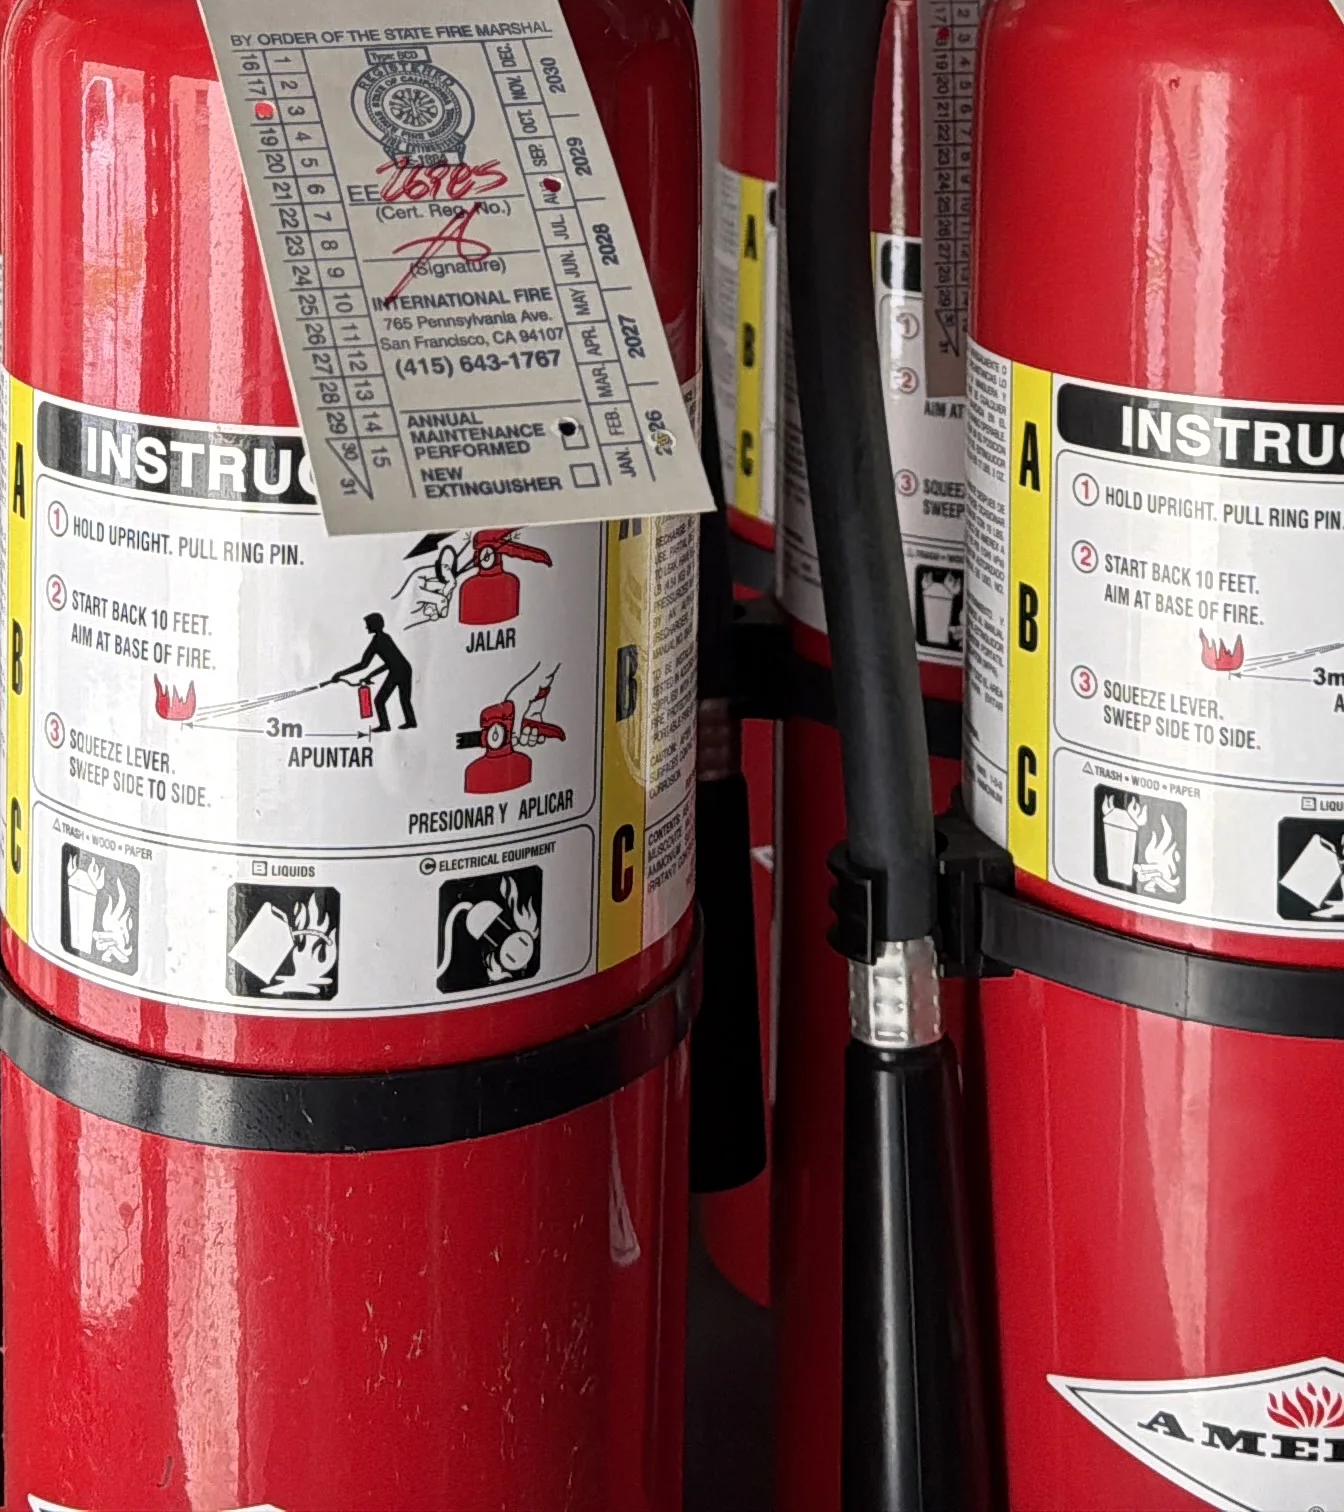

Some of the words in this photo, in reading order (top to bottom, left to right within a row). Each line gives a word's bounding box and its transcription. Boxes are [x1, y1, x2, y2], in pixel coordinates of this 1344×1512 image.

[230, 34, 252, 46] BY
[256, 31, 318, 46] ORDER
[320, 30, 344, 43] OF
[345, 28, 382, 42] THE
[383, 26, 434, 40] STATE
[434, 24, 474, 38] FIRE
[474, 20, 553, 37] MARSHAL
[539, 56, 566, 93] 2030
[346, 183, 383, 202] EE
[374, 202, 424, 224] (Cert.
[371, 289, 511, 312] INTERNATIONAL
[512, 286, 553, 303] FIRE
[379, 336, 411, 351] San
[413, 333, 490, 349] Francisco,
[492, 329, 517, 345] CA
[518, 326, 564, 343] 94107
[382, 316, 413, 331] 765
[416, 310, 517, 329] Pennsylvania
[520, 309, 553, 323] Ave.
[395, 355, 454, 381] (415)
[459, 349, 561, 373] 643-1767
[407, 411, 483, 428] ANNUAL
[409, 422, 546, 444] MAINTENANCE
[414, 439, 530, 460] PERFORMED
[1019, 421, 1041, 491] A
[13, 441, 25, 520] A
[420, 466, 462, 482] NEW
[424, 476, 563, 499] EXTINGUISHER
[1106, 486, 1142, 511] HOLD
[1147, 494, 1217, 521] UPRIGHT.
[1224, 504, 1264, 526] PULL
[1269, 507, 1309, 529] RING
[73, 515, 104, 543] HOLD
[109, 525, 173, 555] UPRIGHT.
[179, 536, 217, 560] PULL
[224, 541, 263, 564] RING
[269, 544, 304, 566] PIN.
[1105, 554, 1148, 580] START
[1152, 563, 1191, 588] BACK
[1196, 571, 1213, 589] 10
[1219, 572, 1259, 594] FEET.
[72, 590, 107, 618] START
[112, 600, 146, 627] BACK
[151, 609, 168, 630] 10
[173, 612, 212, 636] FEET.
[1019, 581, 1038, 653] B
[1104, 584, 1129, 606] AIM
[1134, 591, 1151, 610] AT
[1155, 594, 1194, 617] BASE
[1198, 600, 1219, 620] OF
[1223, 604, 1264, 626] FIRE.
[12, 618, 23, 696] B
[71, 623, 92, 647] AIM
[96, 631, 111, 651] AT
[115, 635, 148, 661] BASE
[153, 642, 172, 664] OF
[178, 647, 216, 670] FIRE.
[465, 628, 516, 654] JALAR
[616, 645, 637, 722] B
[1104, 680, 1166, 711] SQUEEZE
[1170, 695, 1224, 720] LEVER.
[266, 718, 303, 738] 3m
[1103, 706, 1152, 733] SWEEP
[1155, 719, 1190, 741] SIDE
[1195, 725, 1214, 744] TO
[1219, 727, 1261, 750] SIDE.
[70, 729, 123, 763] SQUEEZE
[127, 745, 175, 774] LEVER.
[288, 747, 373, 768] APUNTAR
[69, 756, 109, 787] SWEEP
[113, 774, 144, 797] SIDE
[149, 778, 165, 801] TO
[171, 783, 211, 808] SIDE.
[1017, 744, 1037, 817] C
[1094, 764, 1123, 782] TRASH
[1131, 775, 1160, 791] WOOD
[1169, 784, 1201, 799] PAPER
[408, 807, 495, 835] PRESIONAR
[498, 803, 507, 821] Y
[518, 789, 574, 821] APLICAR
[10, 797, 22, 876] C
[62, 822, 84, 840] TRASH
[92, 835, 116, 851] WOOD
[124, 844, 153, 860] PAPER
[271, 864, 315, 878] LIQUIDS
[439, 854, 499, 873] ELECTRICAL
[502, 842, 555, 863] EQUIPMENT
[613, 824, 634, 903] C
